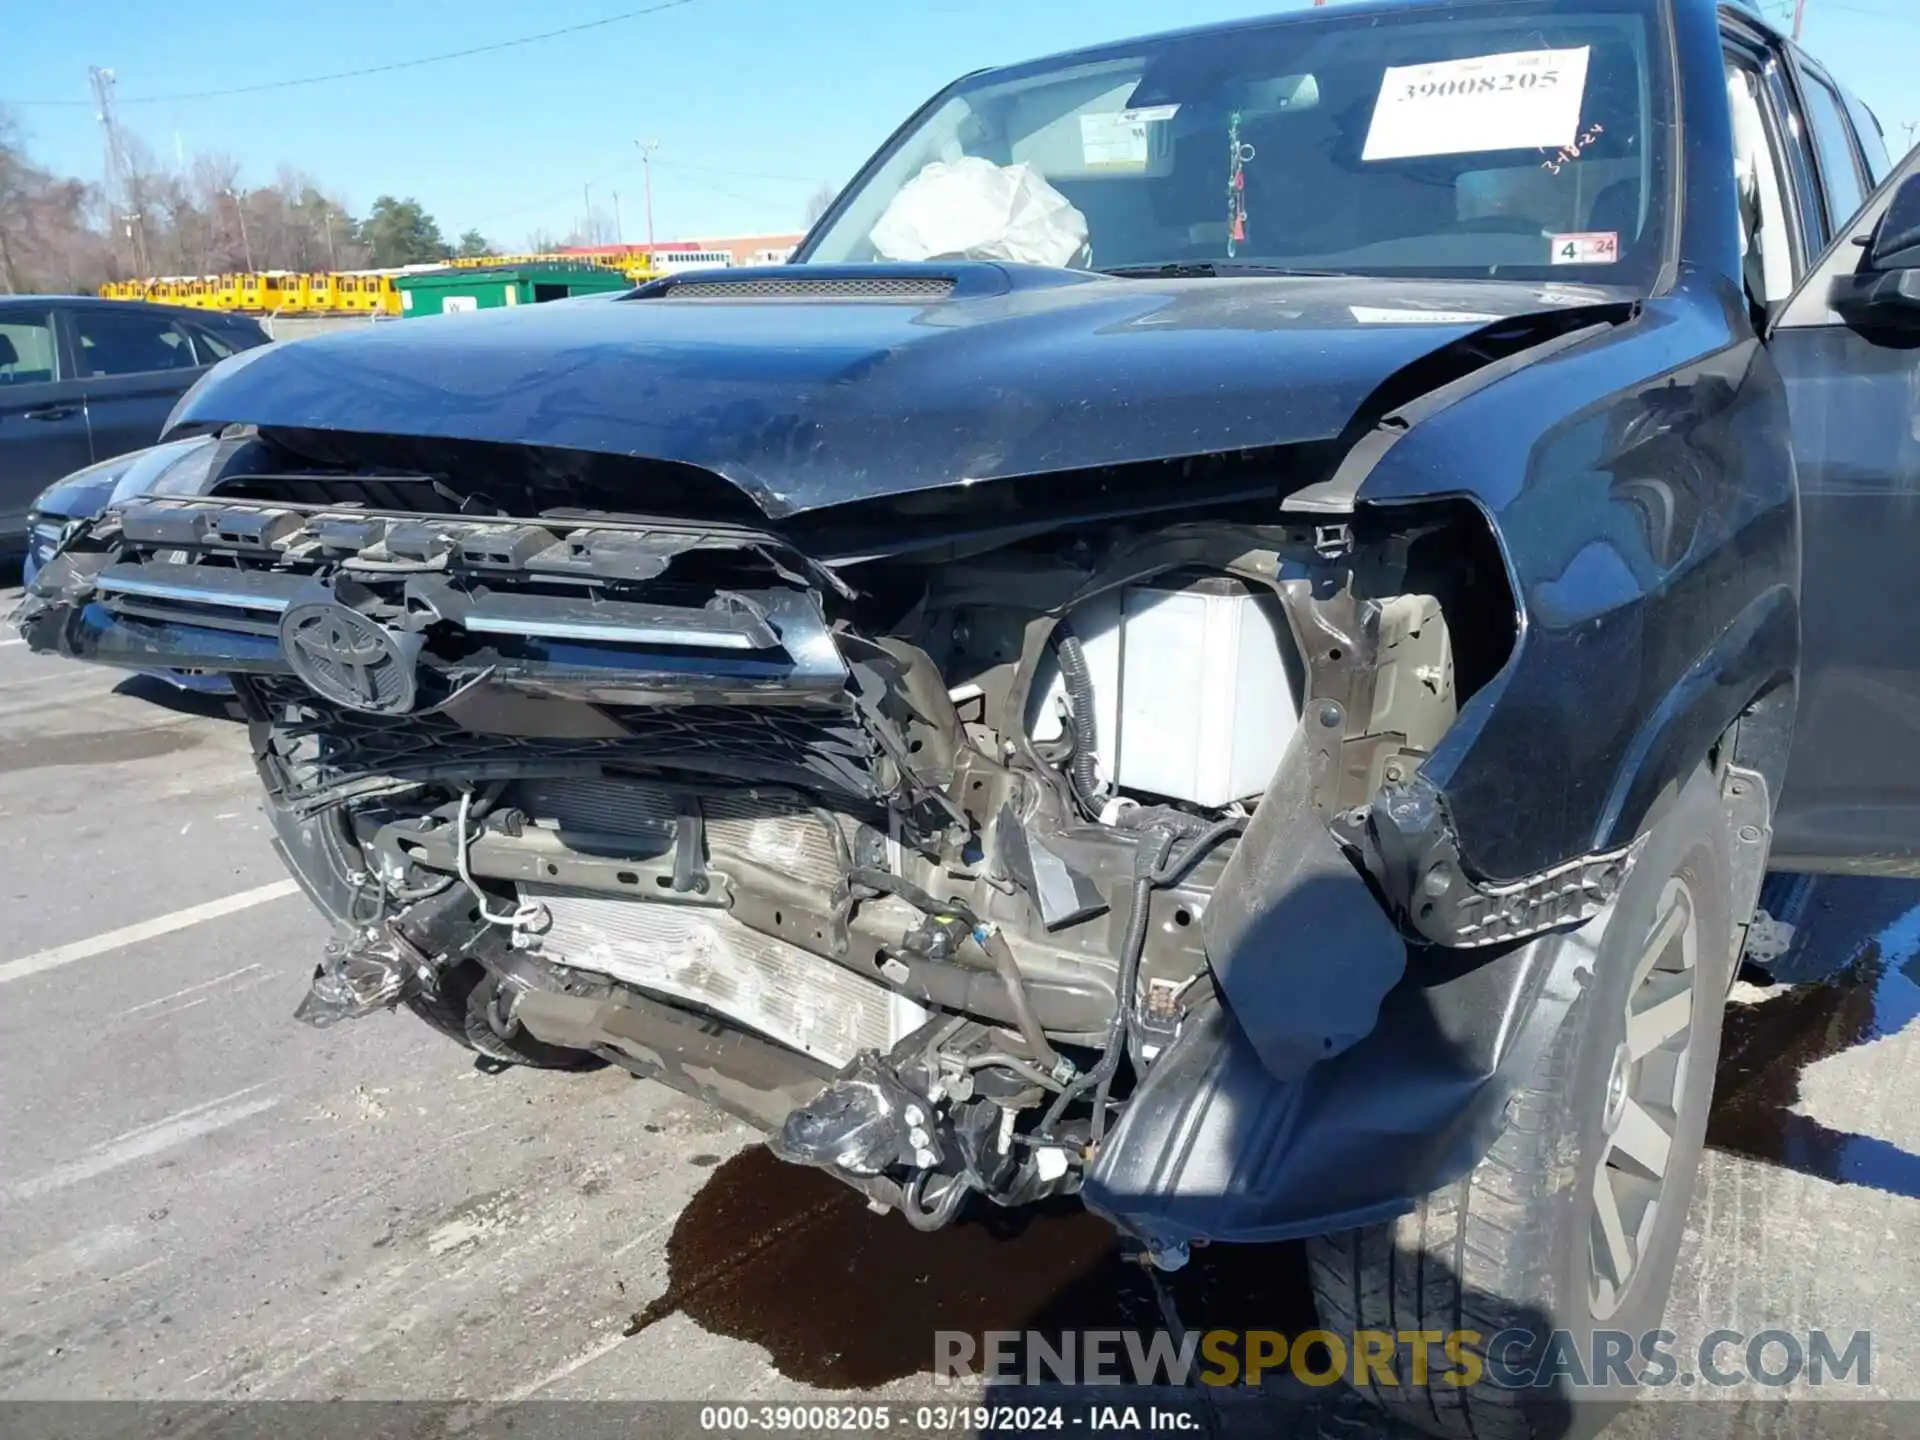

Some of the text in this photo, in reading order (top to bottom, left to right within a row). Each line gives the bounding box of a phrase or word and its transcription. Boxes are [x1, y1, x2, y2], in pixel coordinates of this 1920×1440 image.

[1399, 70, 1559, 102] 39008205
[1561, 240, 1615, 258] 4 24
